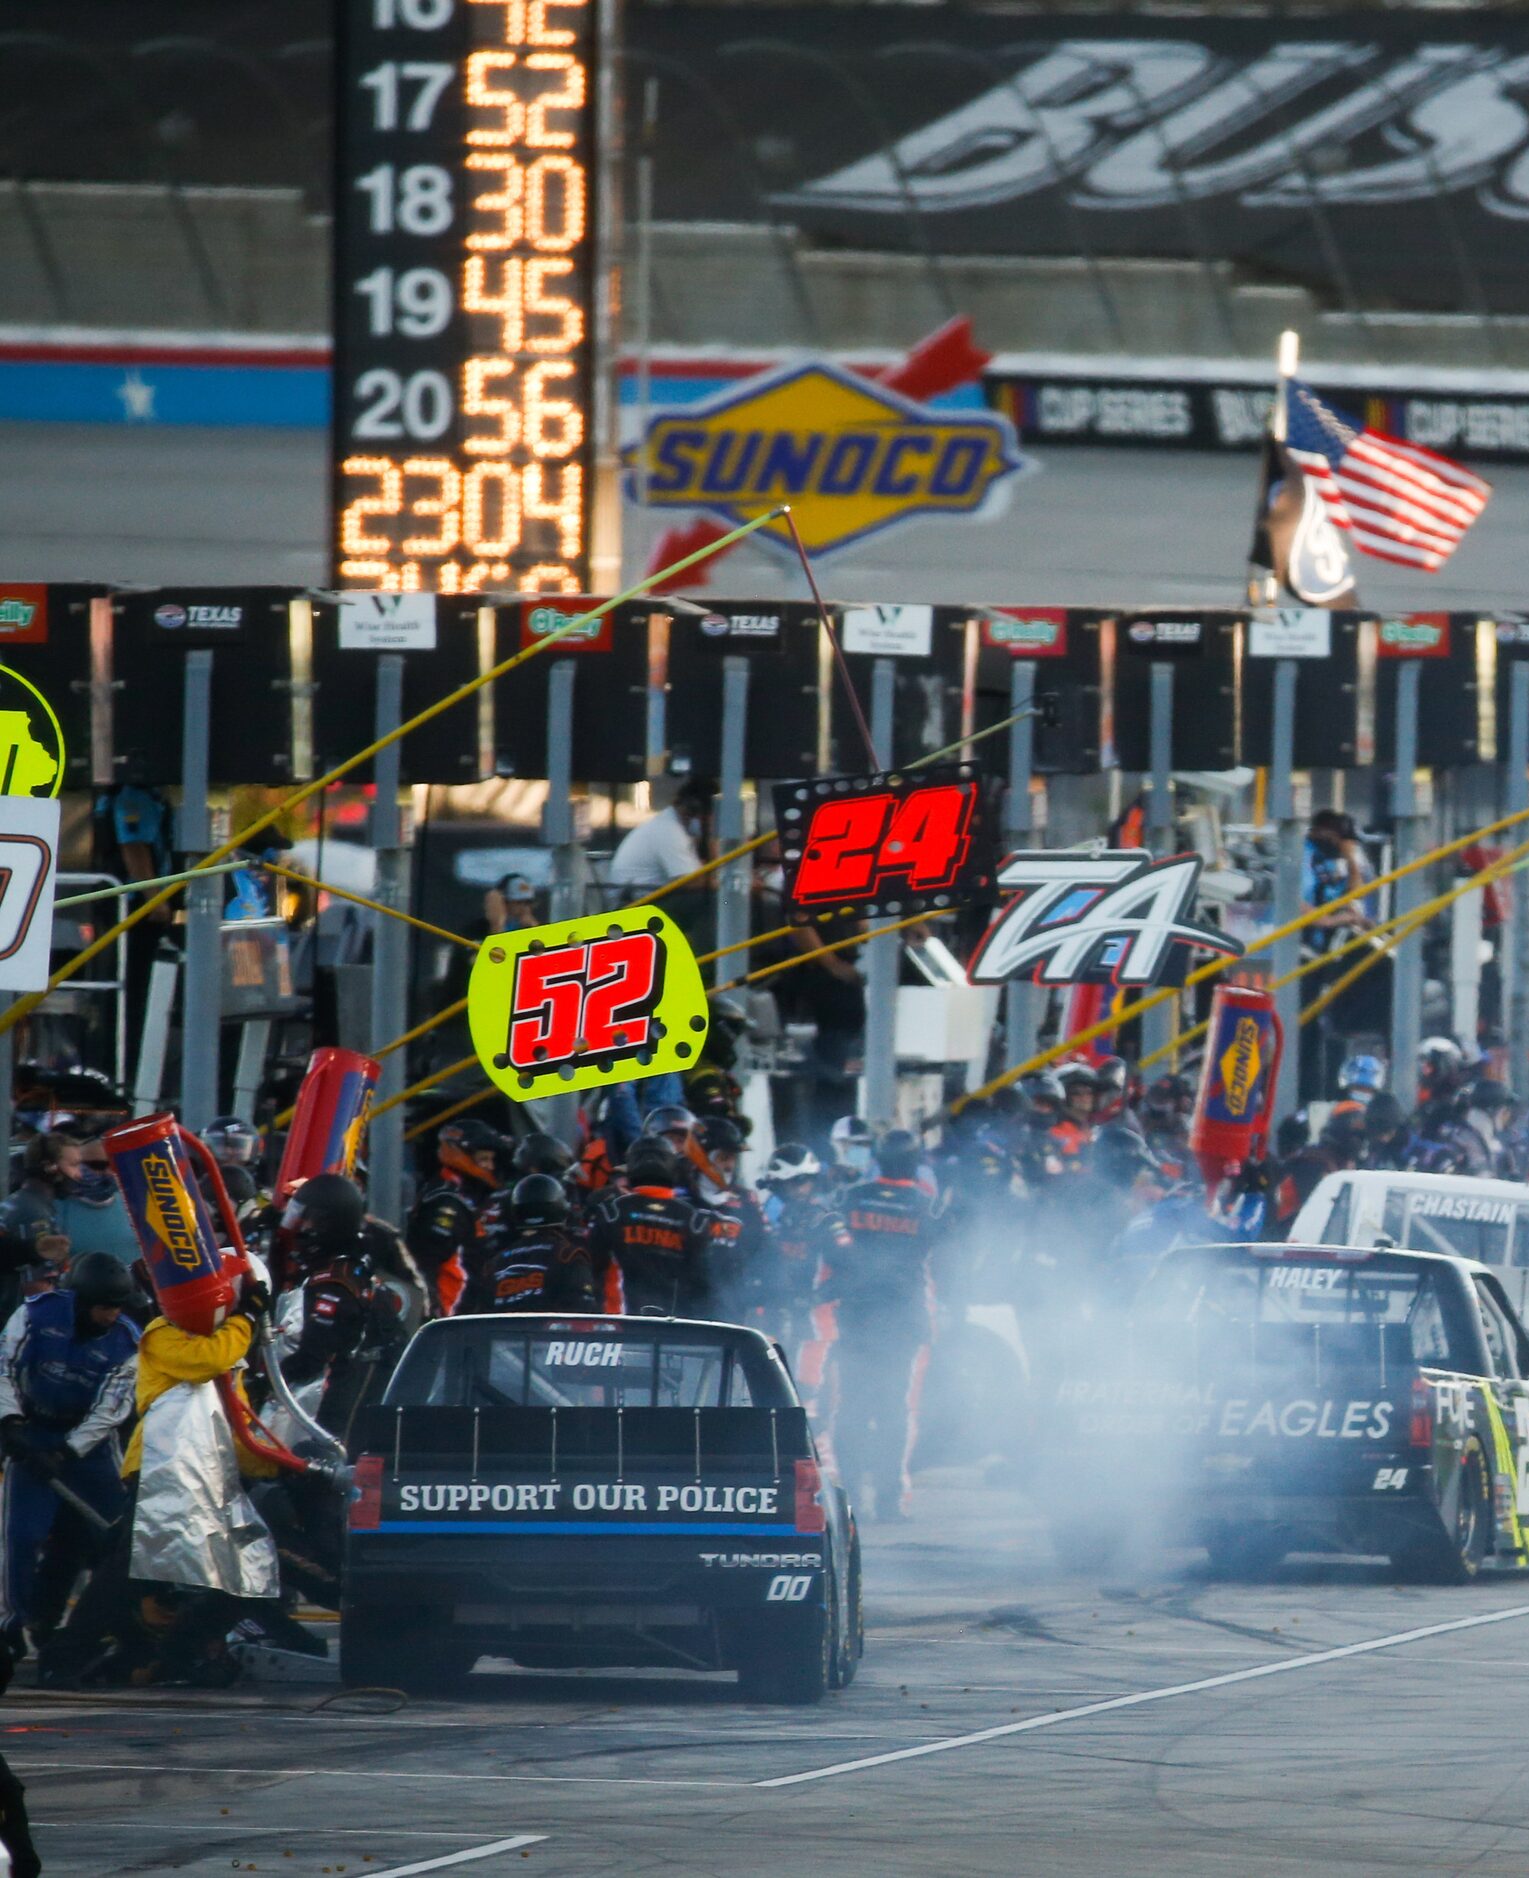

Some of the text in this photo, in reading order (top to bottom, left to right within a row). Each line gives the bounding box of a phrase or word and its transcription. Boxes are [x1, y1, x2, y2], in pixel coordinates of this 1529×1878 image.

[358, 51, 586, 147] 17 52
[354, 153, 587, 250] 18 30
[354, 255, 585, 354] 19 45
[352, 357, 584, 458] 20 56
[645, 424, 993, 498] SUNOCO
[187, 605, 243, 622] TEXAS
[730, 615, 780, 630] TEXAS
[793, 782, 977, 904] 24
[509, 932, 657, 1068] 52
[145, 1158, 200, 1267] SUNOCO
[1409, 1192, 1516, 1225] CHASTAIN
[1270, 1266, 1345, 1290] HALEY
[545, 1341, 623, 1367] RUCH
[1219, 1400, 1394, 1440] EAGLES
[1372, 1467, 1409, 1491] 24
[400, 1484, 778, 1514] SUPPORT OUR POLICE
[698, 1553, 822, 1568] TUNDRA
[766, 1575, 812, 1602] 00
